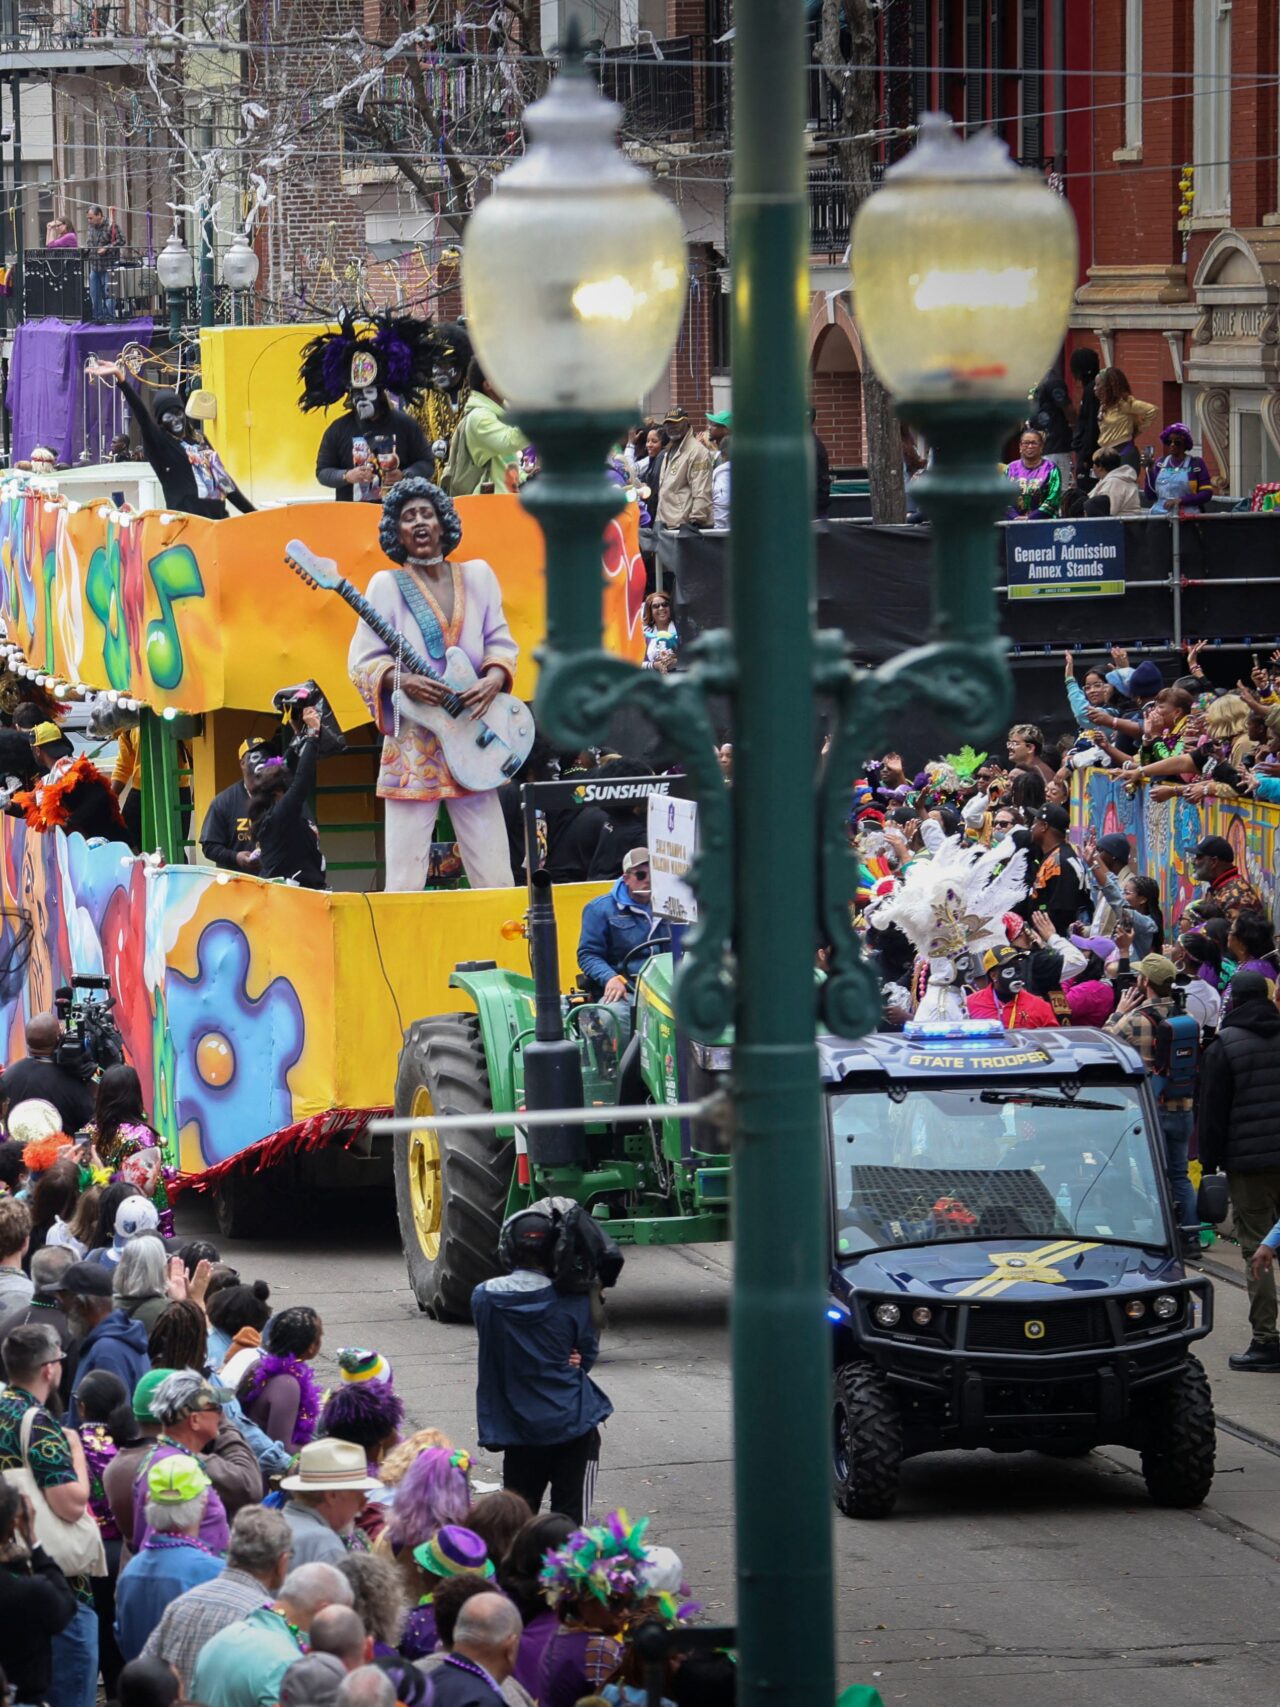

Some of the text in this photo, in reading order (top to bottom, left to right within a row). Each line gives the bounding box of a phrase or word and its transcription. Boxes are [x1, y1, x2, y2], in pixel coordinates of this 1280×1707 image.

[1014, 543, 1117, 562] General Admission
[1028, 561, 1104, 579] Annex Stands
[584, 782, 670, 802] SUNSHINE
[909, 1051, 1049, 1068] STATE TROOPER
